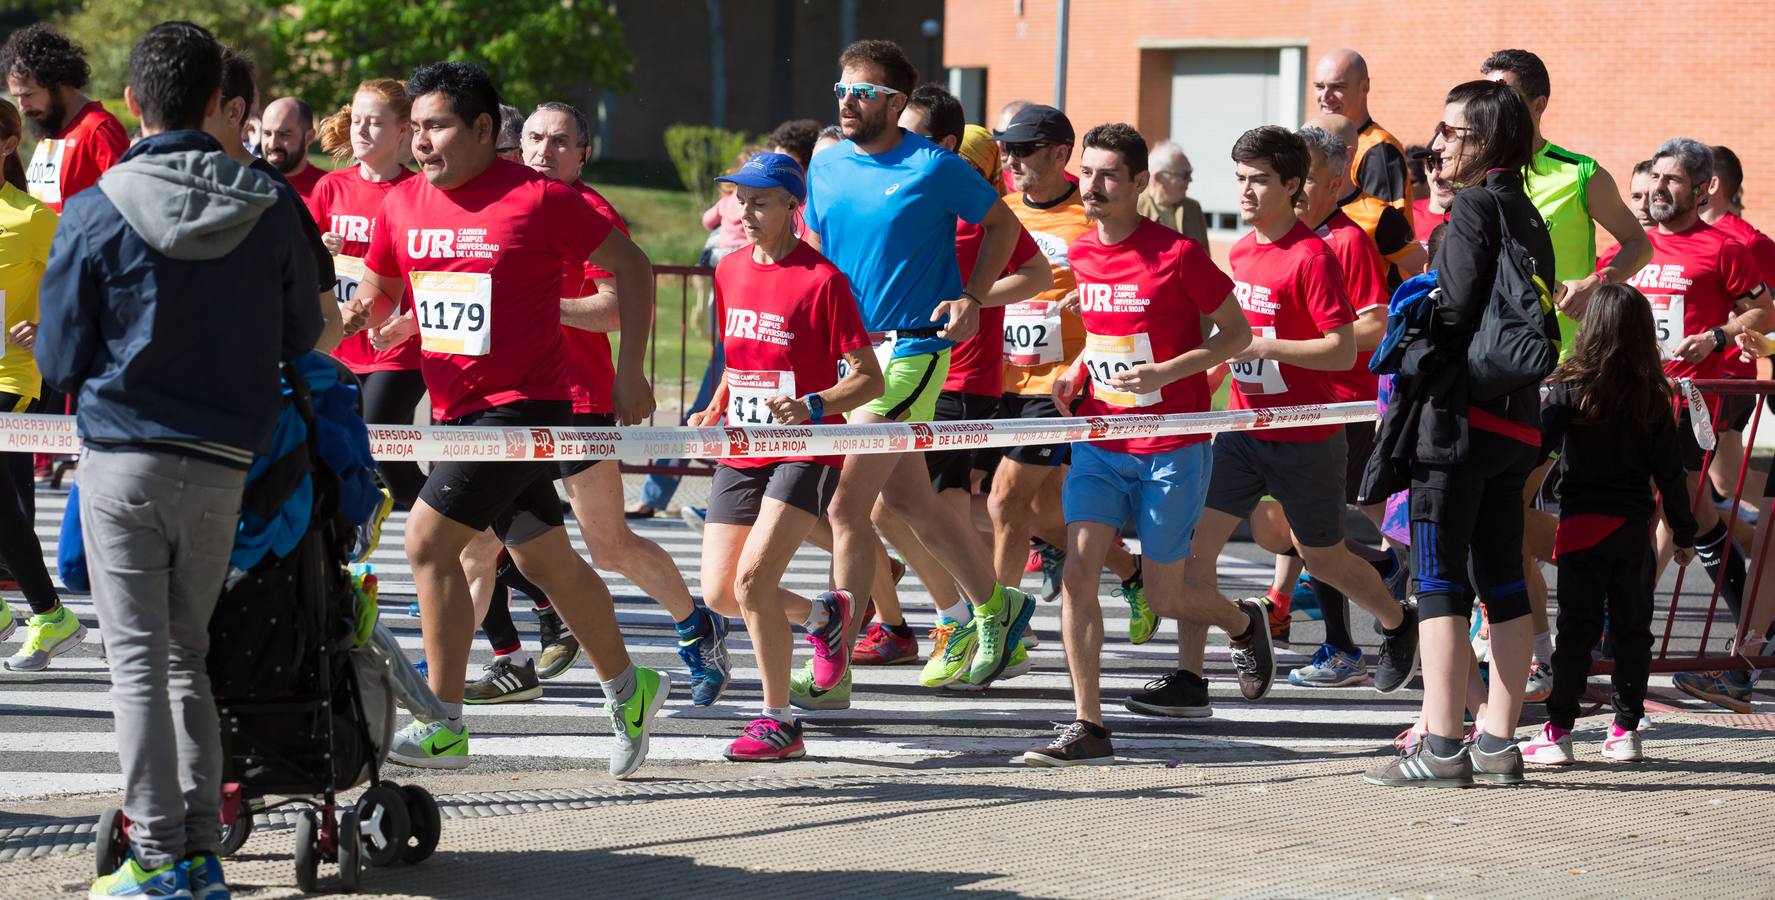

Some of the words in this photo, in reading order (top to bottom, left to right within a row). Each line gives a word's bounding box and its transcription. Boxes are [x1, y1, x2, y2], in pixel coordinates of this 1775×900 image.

[458, 228, 487, 236] CARRERA
[407, 229, 455, 259] UR
[456, 243, 500, 252] UNIVERSIDAD
[474, 251, 493, 259] RIOJA
[1114, 284, 1139, 292] CARRERA
[1079, 283, 1112, 312] UR
[1114, 291, 1136, 299] CAMPUS
[1113, 298, 1150, 306] UNIVERSIDAD
[1128, 305, 1145, 313] RIOJA
[420, 300, 485, 332] 1179
[760, 312, 785, 324] CARRERA
[725, 308, 757, 339] UR
[758, 320, 781, 330] CAMPUS
[757, 327, 795, 340] UNIVERSIDAD
[1005, 325, 1049, 348] 402
[763, 335, 771, 343] LA
[771, 337, 789, 347] RIOJA
[1300, 413, 1321, 423] RIOJA
[751, 428, 813, 439] UNIVERSIDAD
[934, 423, 994, 433] UNIVERSIDAD
[1111, 426, 1122, 435] DE
[1124, 425, 1136, 434] LA
[1138, 424, 1160, 434] RIOJA
[368, 429, 422, 441] IVERSIDAD
[557, 431, 622, 441] UNIVERSIDAD
[938, 435, 950, 446] DE
[952, 434, 963, 445] LA
[965, 433, 988, 446] RIOJA
[371, 445, 384, 455] LA
[386, 444, 414, 457] RIOJA
[560, 444, 573, 455] DE
[575, 444, 587, 455] LA
[590, 443, 616, 457] RIOJA
[754, 441, 766, 451] DE
[768, 440, 780, 451] LA
[782, 440, 807, 453] RIOJA
